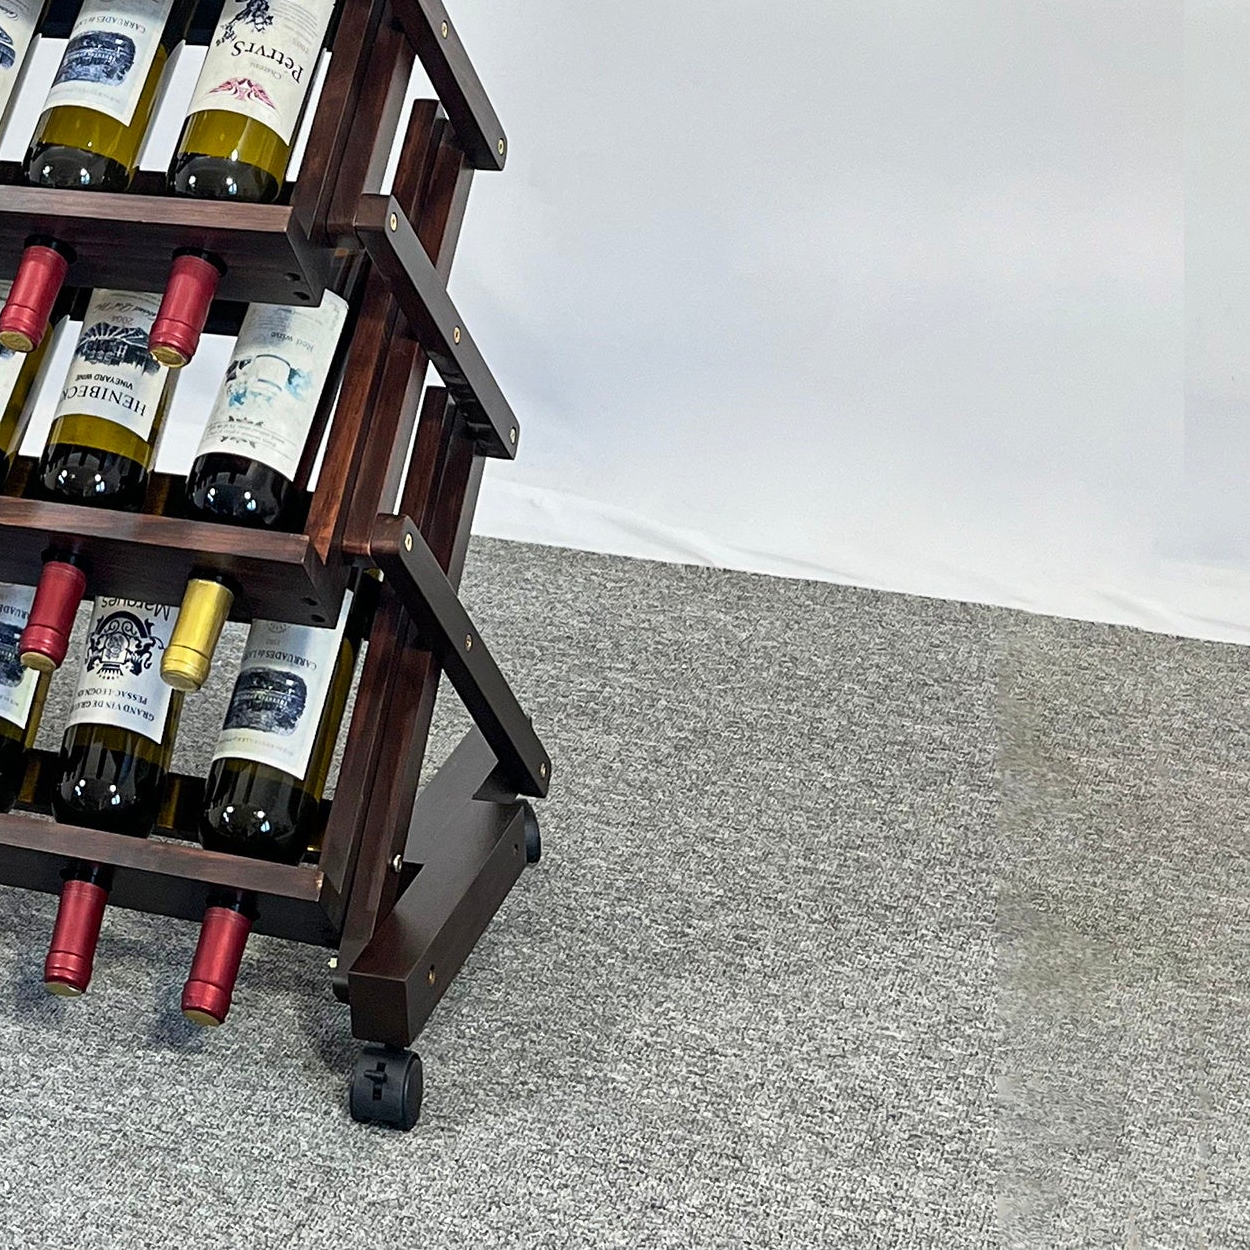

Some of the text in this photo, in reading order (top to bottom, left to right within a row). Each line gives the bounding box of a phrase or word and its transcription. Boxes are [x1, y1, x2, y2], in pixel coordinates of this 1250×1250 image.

[270, 331, 315, 352] Red wine
[93, 373, 134, 392] VINEYARD
[265, 649, 317, 671] CARRUADES
[122, 704, 155, 722] GRAND
